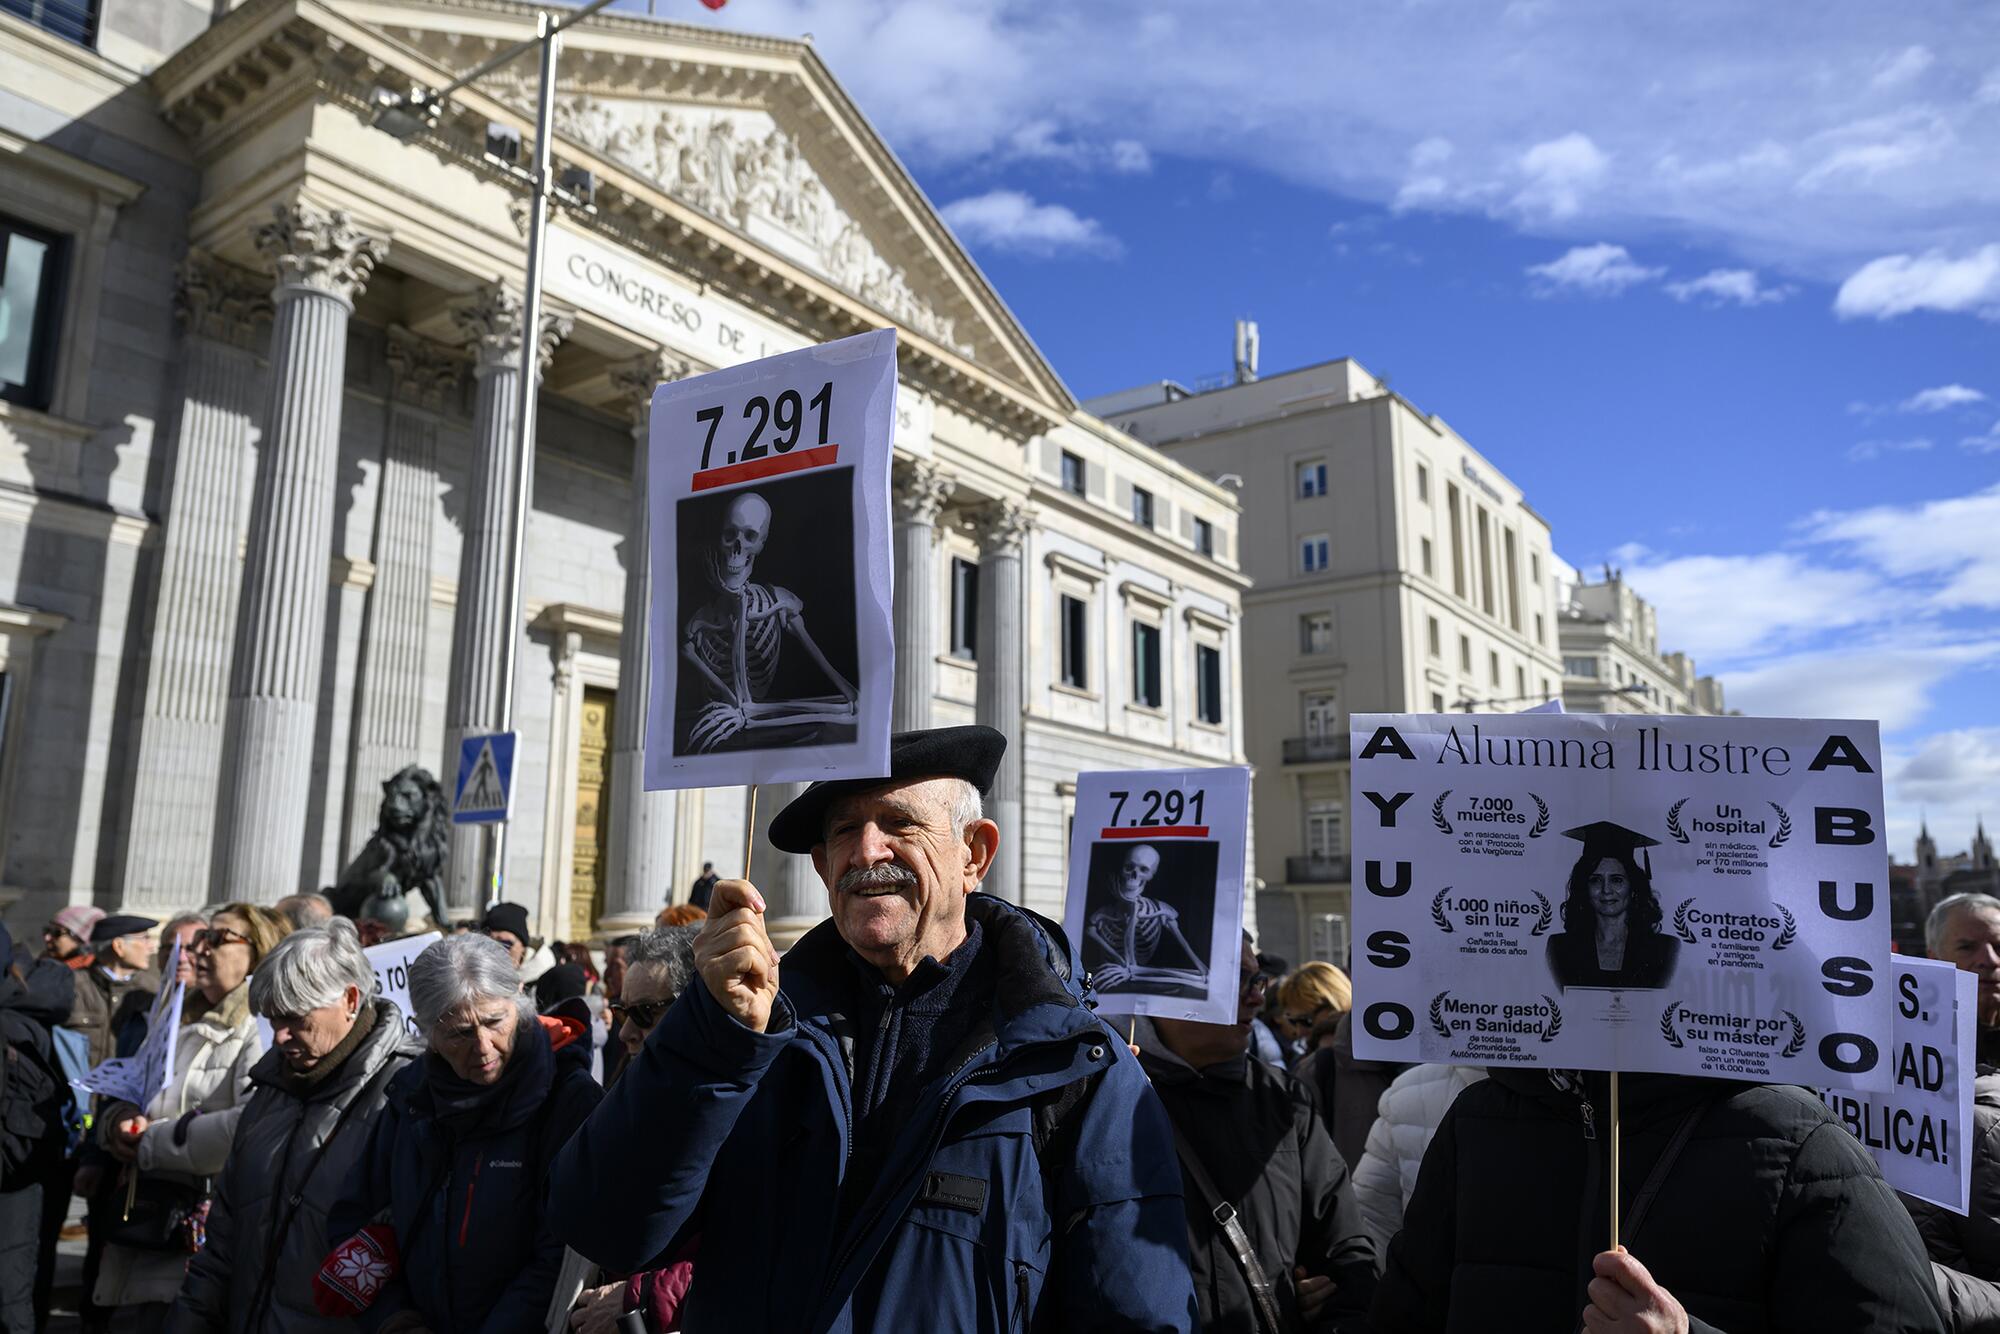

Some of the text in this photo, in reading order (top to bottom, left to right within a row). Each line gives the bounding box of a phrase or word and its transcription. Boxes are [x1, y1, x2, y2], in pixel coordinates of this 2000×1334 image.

[568, 254, 745, 354] CONGRESO DE
[697, 381, 833, 470] 7.291
[1437, 724, 1792, 776] Alumna Ilustre
[1109, 789, 1206, 828] 7.291
[1469, 797, 1513, 811] 7.000
[1716, 804, 1742, 818] Un
[1457, 811, 1526, 824] muertes
[1692, 818, 1766, 836] hospital
[1475, 831, 1521, 840] residencias
[1716, 851, 1759, 859] pacientes
[1696, 859, 1711, 867] por
[1732, 859, 1769, 868] millones
[1358, 727, 1417, 1040] AYUSO
[1445, 898, 1540, 914] 1.000 niños
[1808, 735, 1880, 1074] ABUSO
[1465, 912, 1520, 927] sin luz
[1687, 909, 1780, 929] Contratos
[1701, 926, 1765, 942] a dedo
[1466, 937, 1518, 947] Cañada Real
[1718, 942, 1760, 952] familiares
[1460, 946, 1528, 955] más de dos años
[1723, 951, 1755, 960] amigos
[1721, 959, 1764, 969] pandemia
[1444, 998, 1549, 1019] Menor gasto
[1450, 1018, 1543, 1034] en Sanidad
[1679, 1009, 1788, 1032] Premiar por
[1481, 1035, 1504, 1043] todas
[1505, 1036, 1517, 1044] las
[1686, 1028, 1779, 1046] su máster
[1467, 1042, 1521, 1052] Comunidades
[1698, 1046, 1719, 1054] falso
[1729, 1048, 1770, 1059] Cifuentes
[1496, 1052, 1508, 1060] de
[1509, 1052, 1537, 1062] España
[1736, 1058, 1766, 1067] retrato
[1701, 1061, 1712, 1070] de
[1745, 1067, 1770, 1075] euros
[1893, 1042, 1944, 1092] AD
